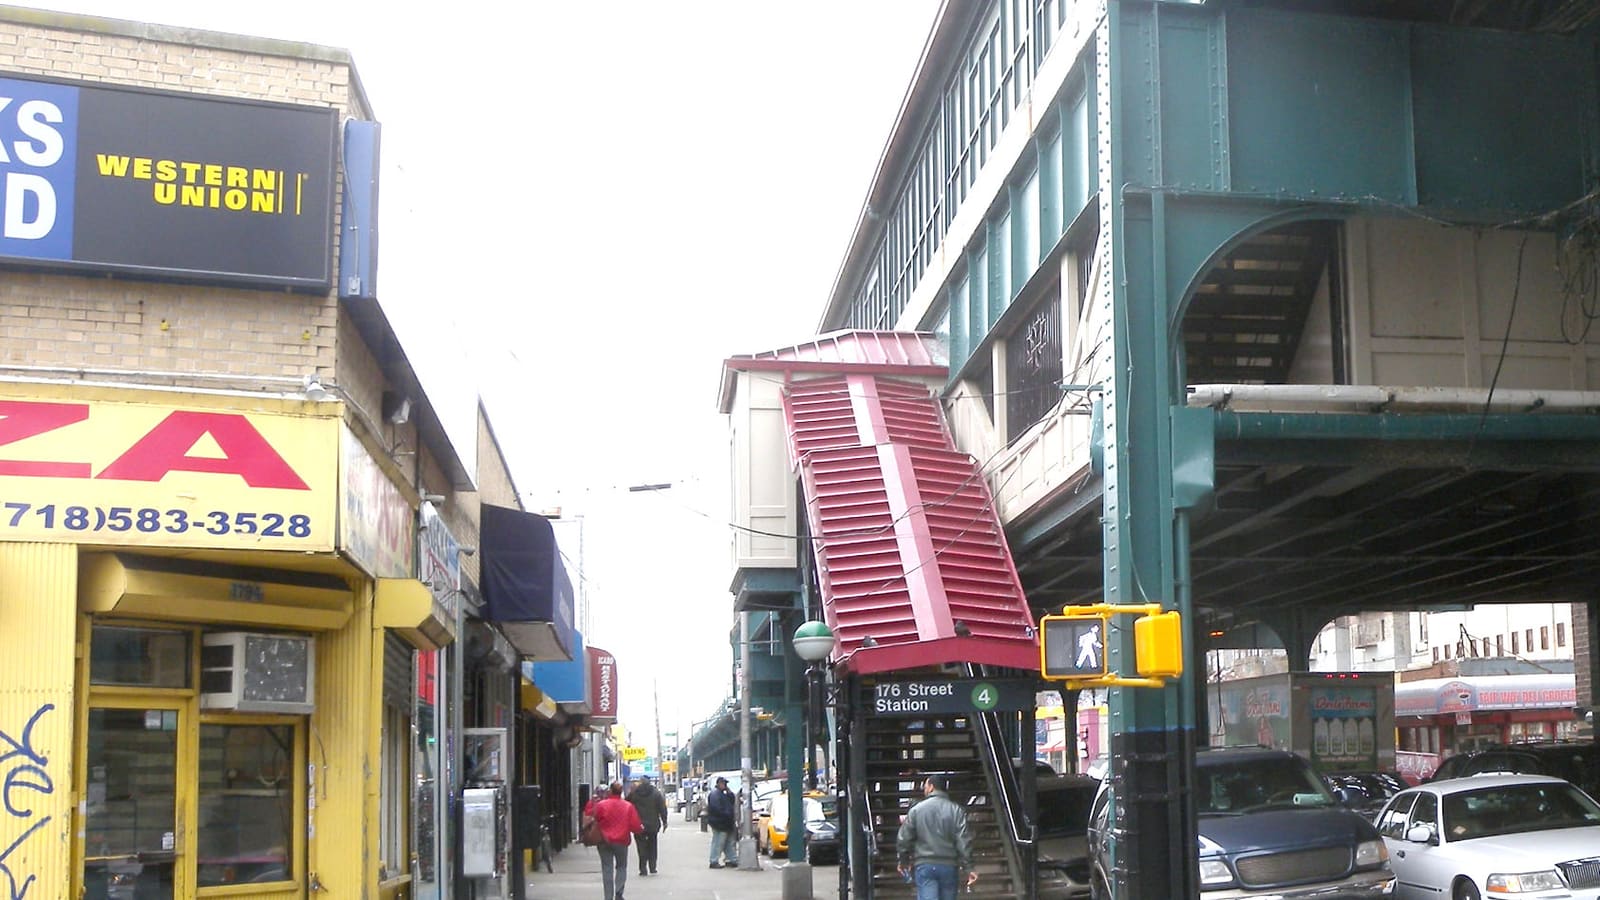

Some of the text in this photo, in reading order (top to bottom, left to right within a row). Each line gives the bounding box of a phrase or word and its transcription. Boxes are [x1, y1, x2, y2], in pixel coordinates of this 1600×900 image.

[96, 154, 276, 190] WESTERN
[153, 182, 275, 214] UNION
[876, 682, 953, 697] 176 Street
[977, 688, 991, 704] 4
[875, 698, 928, 712] Station
